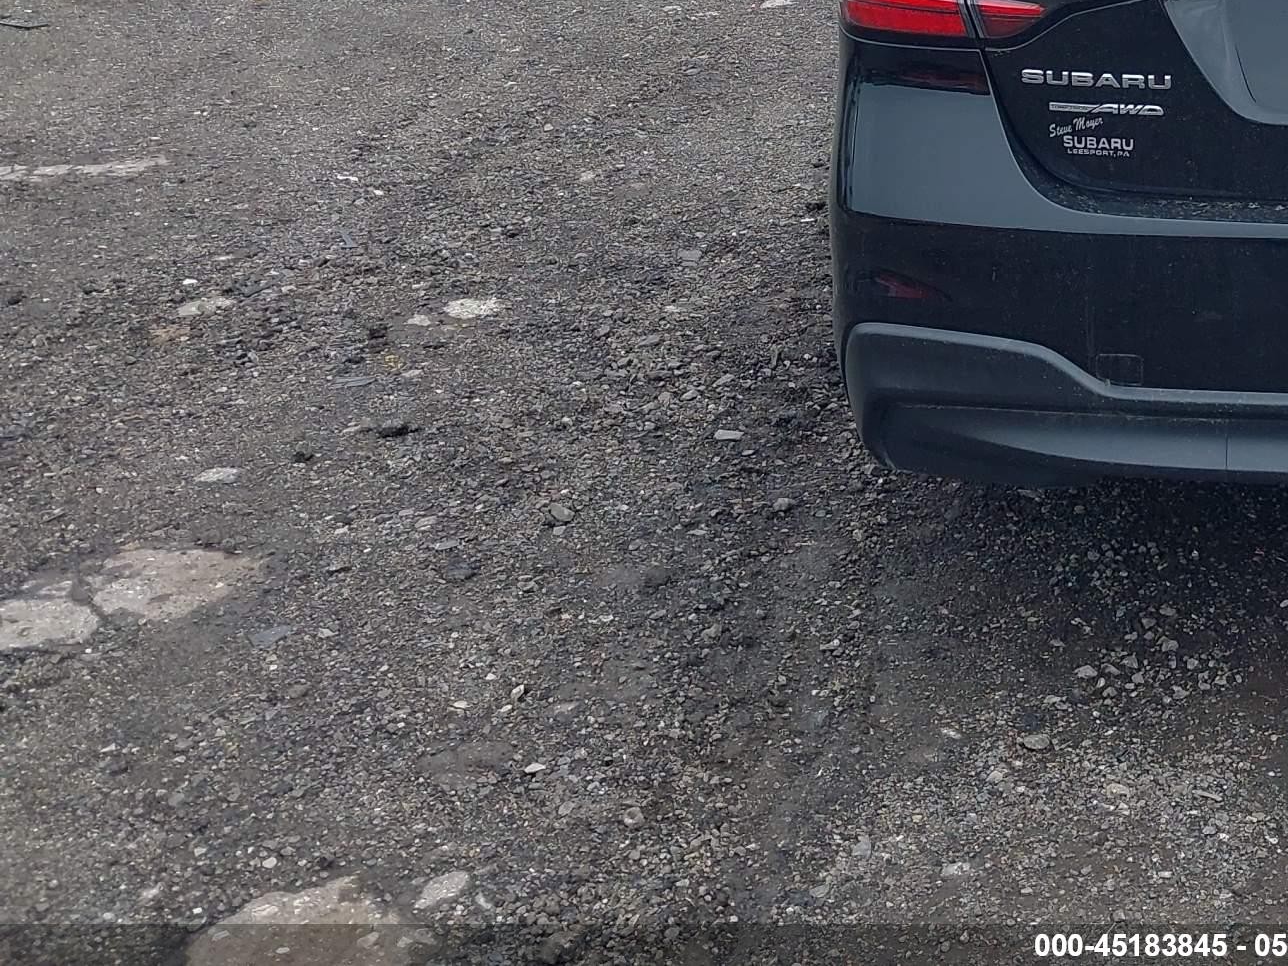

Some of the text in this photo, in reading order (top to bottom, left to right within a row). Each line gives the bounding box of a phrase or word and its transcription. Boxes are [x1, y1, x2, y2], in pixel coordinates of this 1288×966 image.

[1021, 69, 1172, 90] SUBARU
[1090, 103, 1164, 116] AWD
[1049, 116, 1104, 138] Steve Moyer
[1063, 135, 1134, 151] SUBARU
[1067, 148, 1116, 158] LEESPORT,
